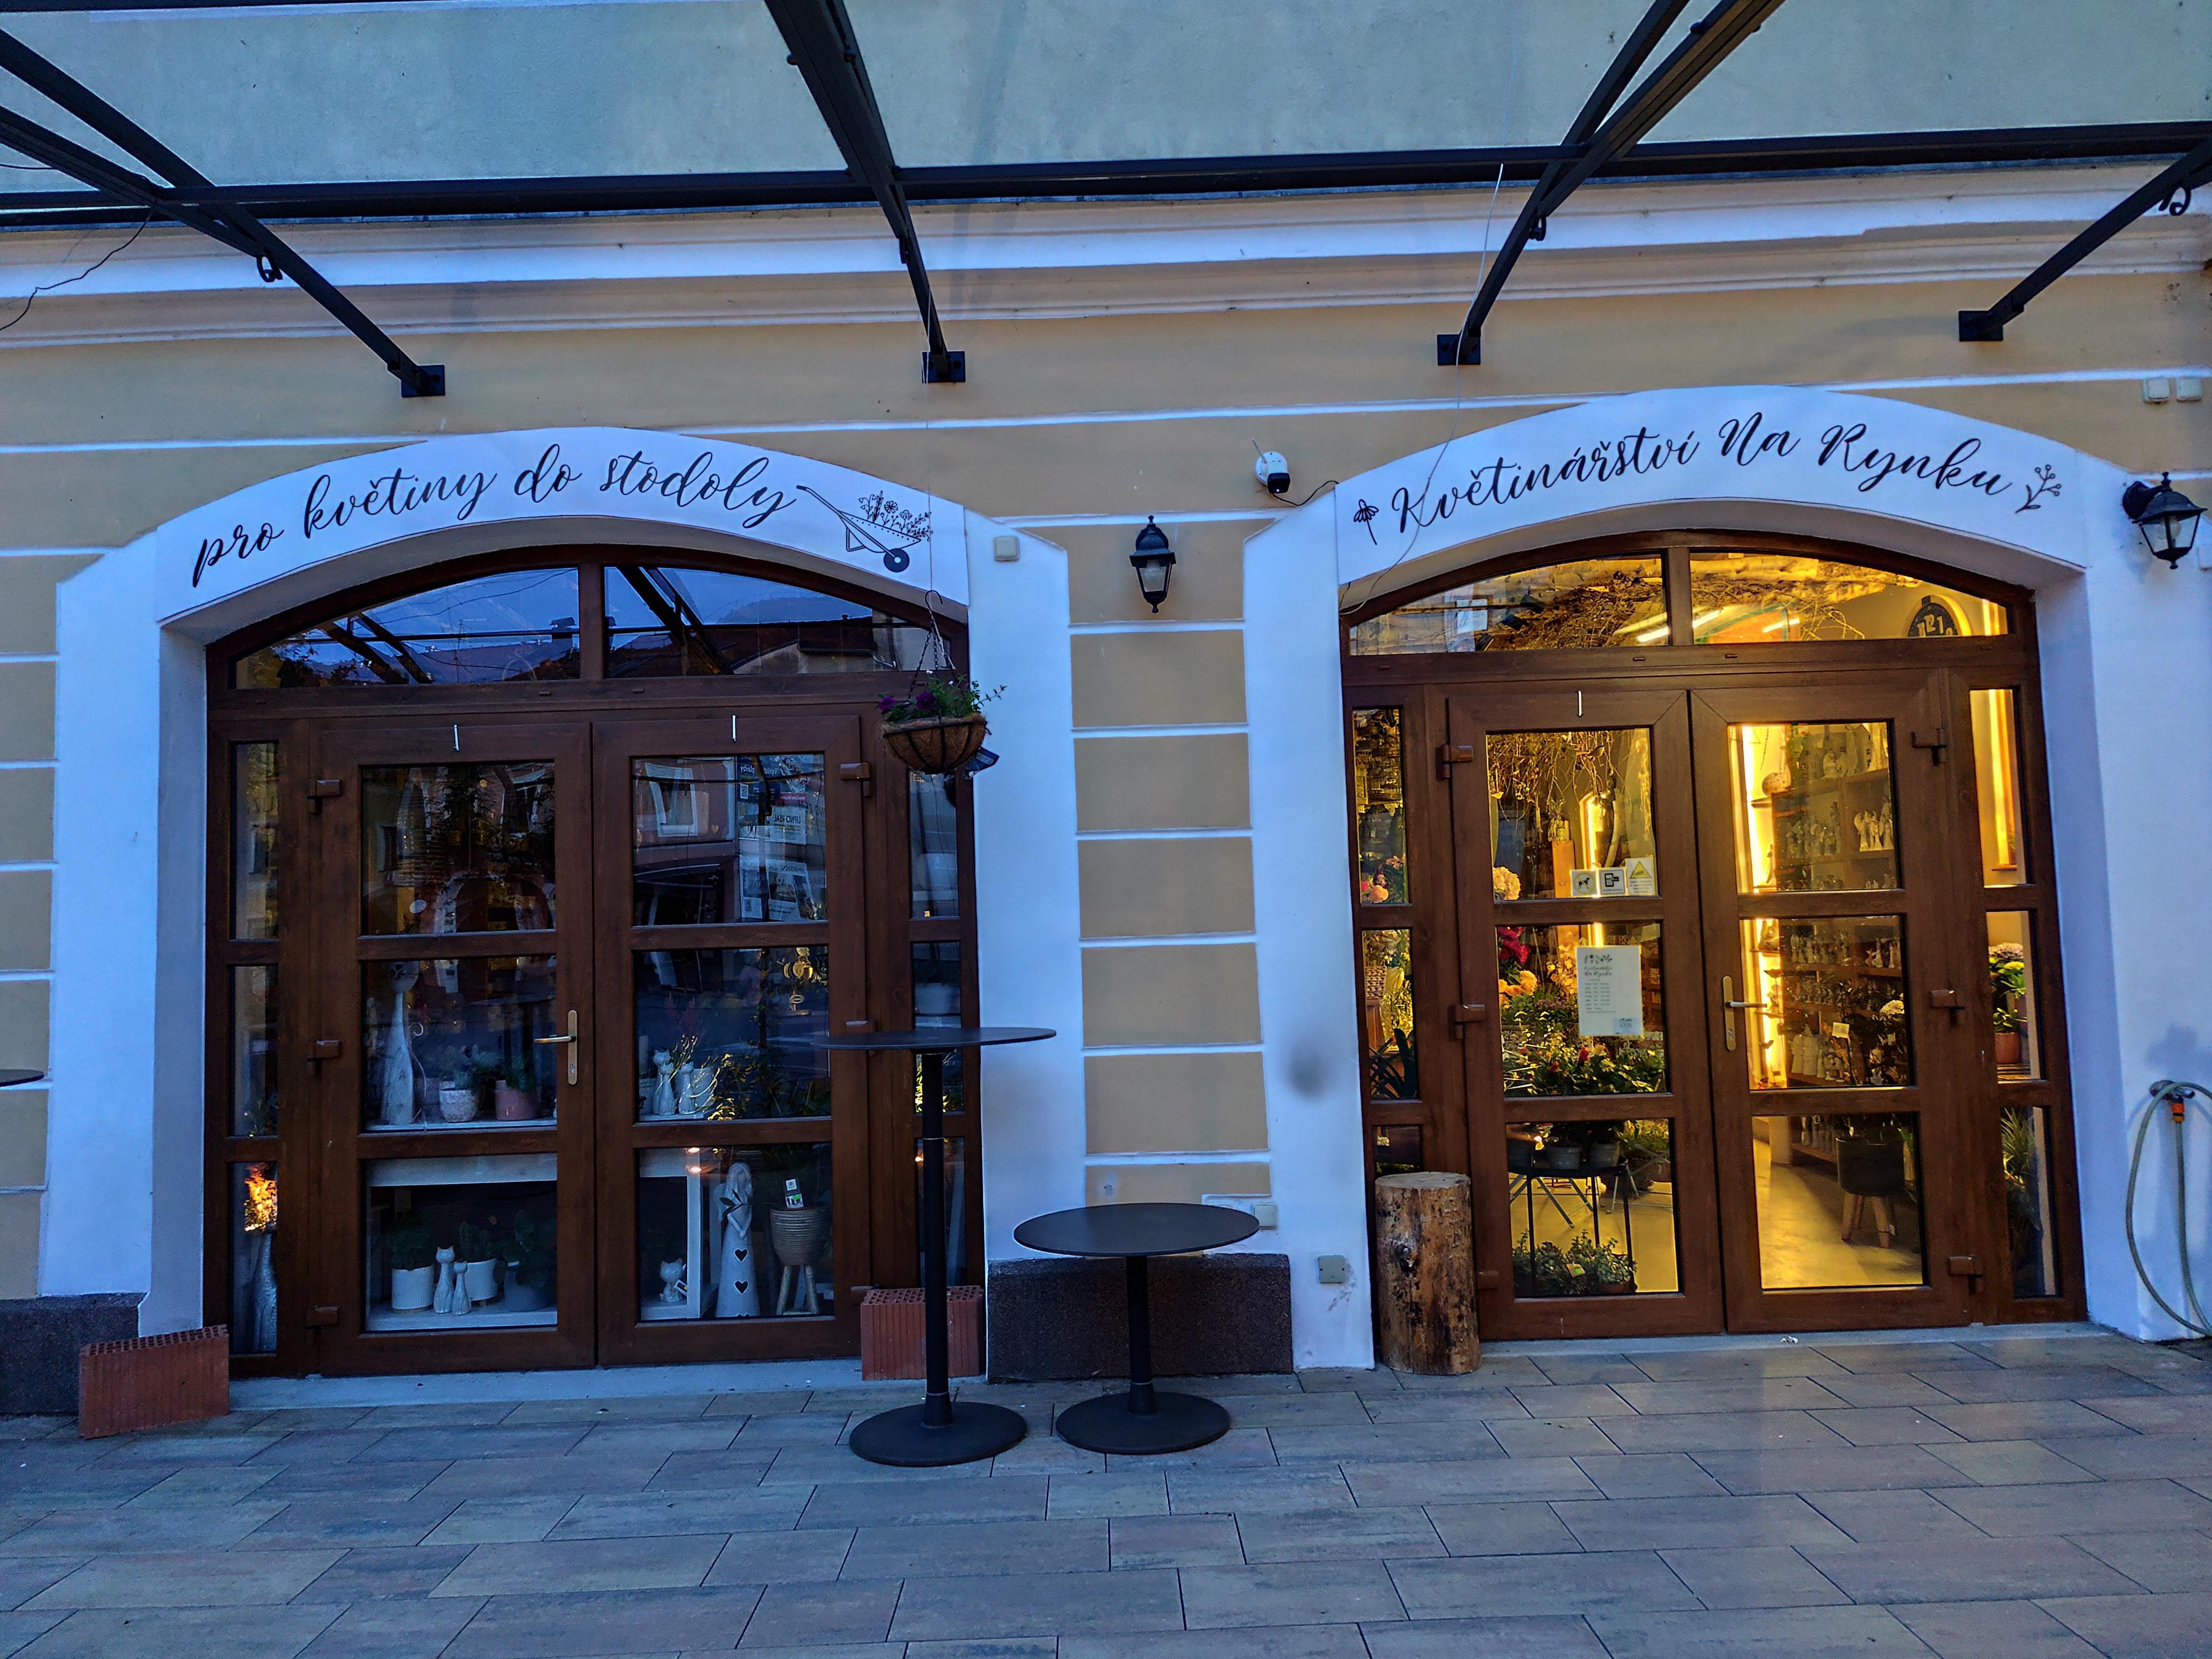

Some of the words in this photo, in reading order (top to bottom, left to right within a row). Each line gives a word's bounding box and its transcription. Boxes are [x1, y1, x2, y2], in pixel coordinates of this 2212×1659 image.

[192, 523, 284, 588] pro
[304, 467, 497, 539] květiny
[514, 444, 582, 503] do
[599, 451, 797, 529] stodoly
[1392, 426, 1700, 534] Květinářství
[1719, 412, 1801, 466] Na
[1818, 424, 2013, 495] Rynku
